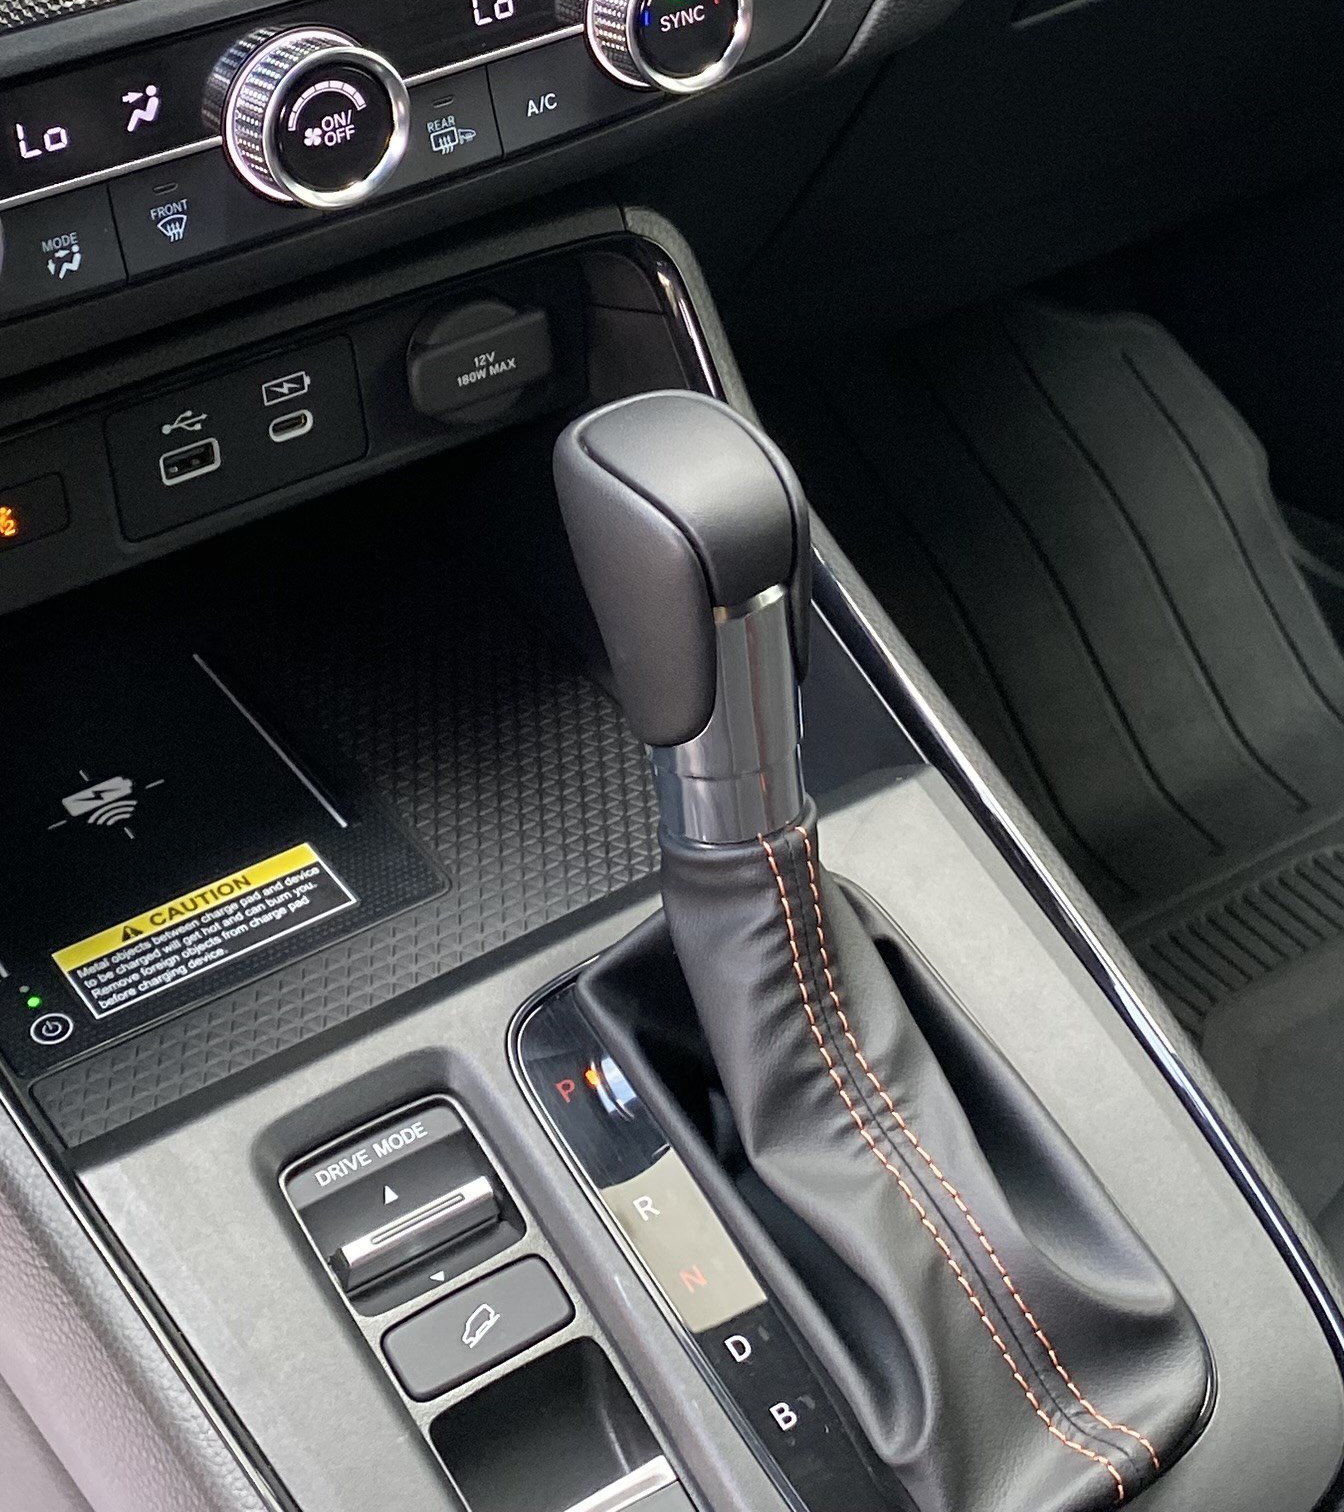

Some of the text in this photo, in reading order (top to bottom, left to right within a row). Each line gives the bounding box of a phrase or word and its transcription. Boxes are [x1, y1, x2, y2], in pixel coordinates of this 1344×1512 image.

[659, 4, 706, 33] SYNC
[526, 92, 558, 117] A/C
[320, 108, 354, 133] ON/
[427, 115, 455, 133] REAR
[15, 121, 70, 160] Lo
[324, 123, 356, 148] OFF
[150, 198, 189, 221] FRONT
[41, 231, 79, 254] MODE
[457, 357, 517, 387] 180W MAX
[474, 350, 496, 368] 12V
[149, 875, 252, 927] CAUTION
[76, 866, 320, 980] Metal objects between charge pad and device
[83, 881, 319, 990] to be charged will get hot and can burn you.
[90, 896, 310, 999] Remove foreign objects from charge pad
[98, 946, 229, 1009] before charging device.
[556, 1077, 576, 1103] P
[314, 1119, 429, 1188] DRIVE MODE
[632, 1195, 661, 1222] R
[678, 1266, 709, 1293] N
[724, 1334, 753, 1363] D
[769, 1402, 799, 1431] B
